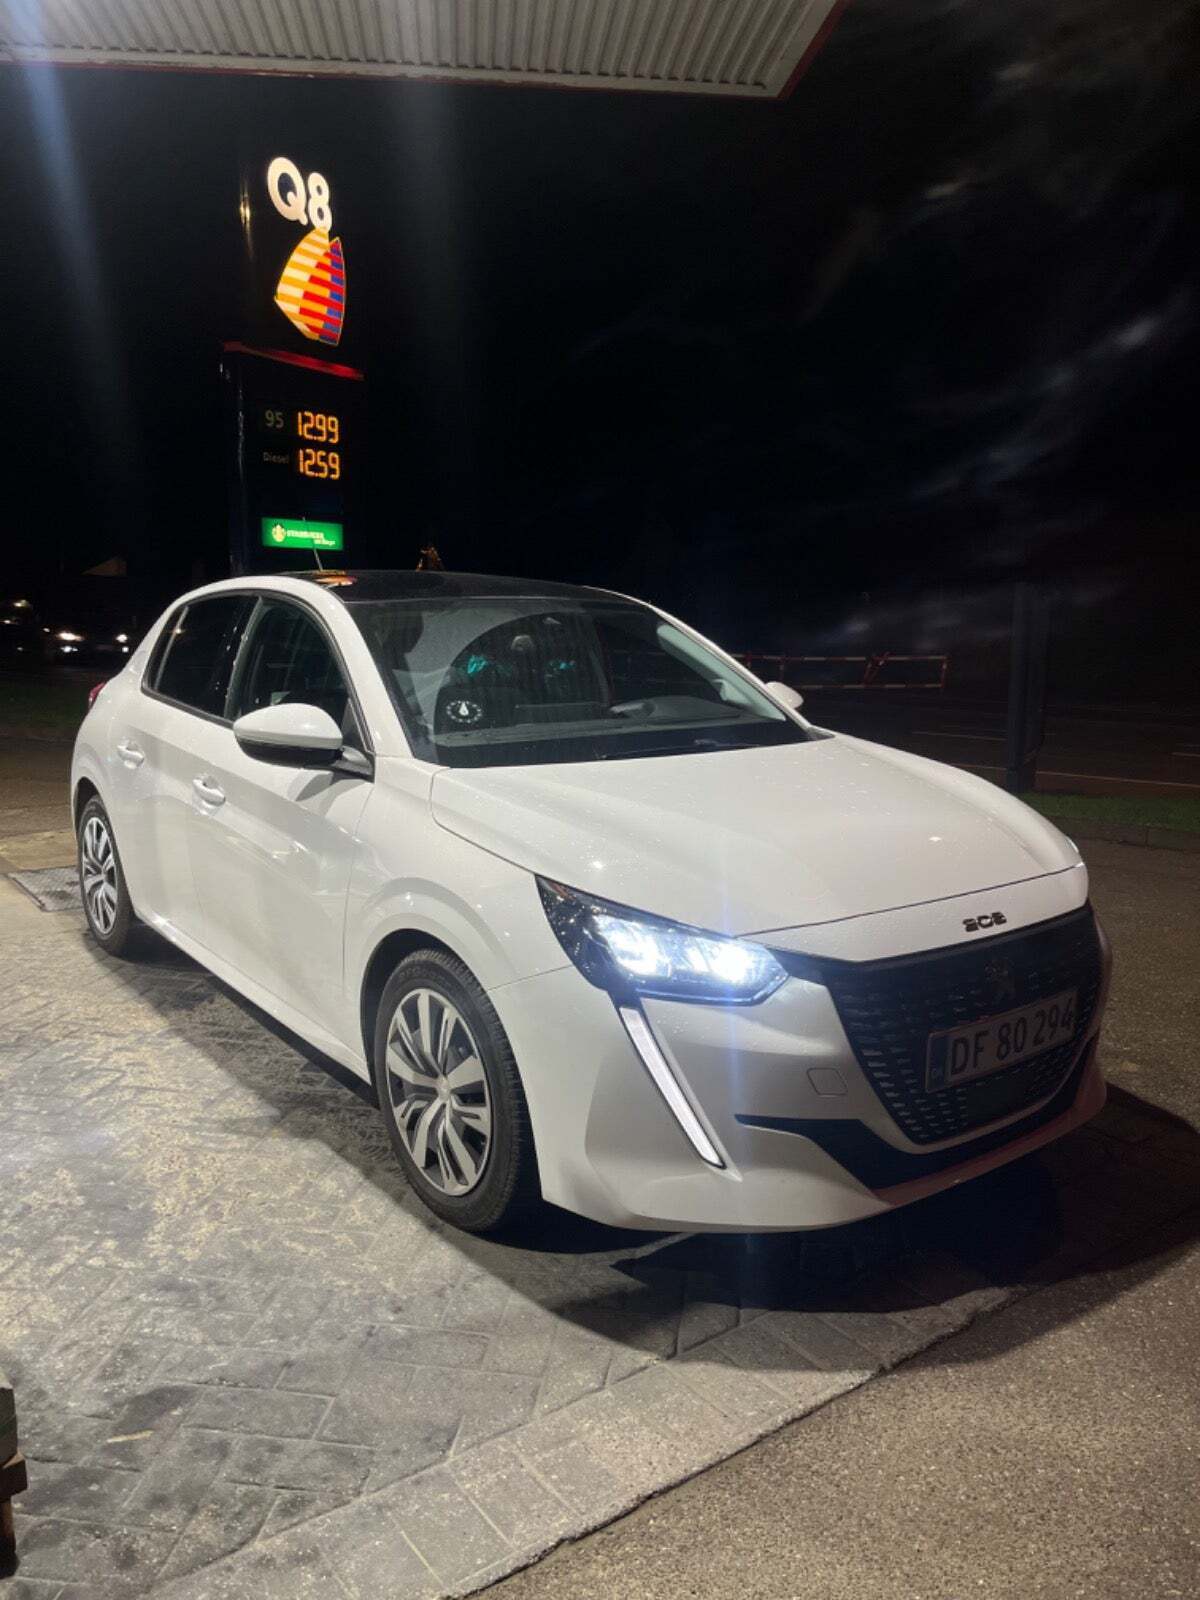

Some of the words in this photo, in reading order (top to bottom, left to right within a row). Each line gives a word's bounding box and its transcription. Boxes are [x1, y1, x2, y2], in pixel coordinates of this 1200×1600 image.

[267, 157, 332, 232] Q8
[264, 409, 284, 429] 95
[951, 1030, 988, 1075] DF
[996, 1017, 1027, 1060] 80
